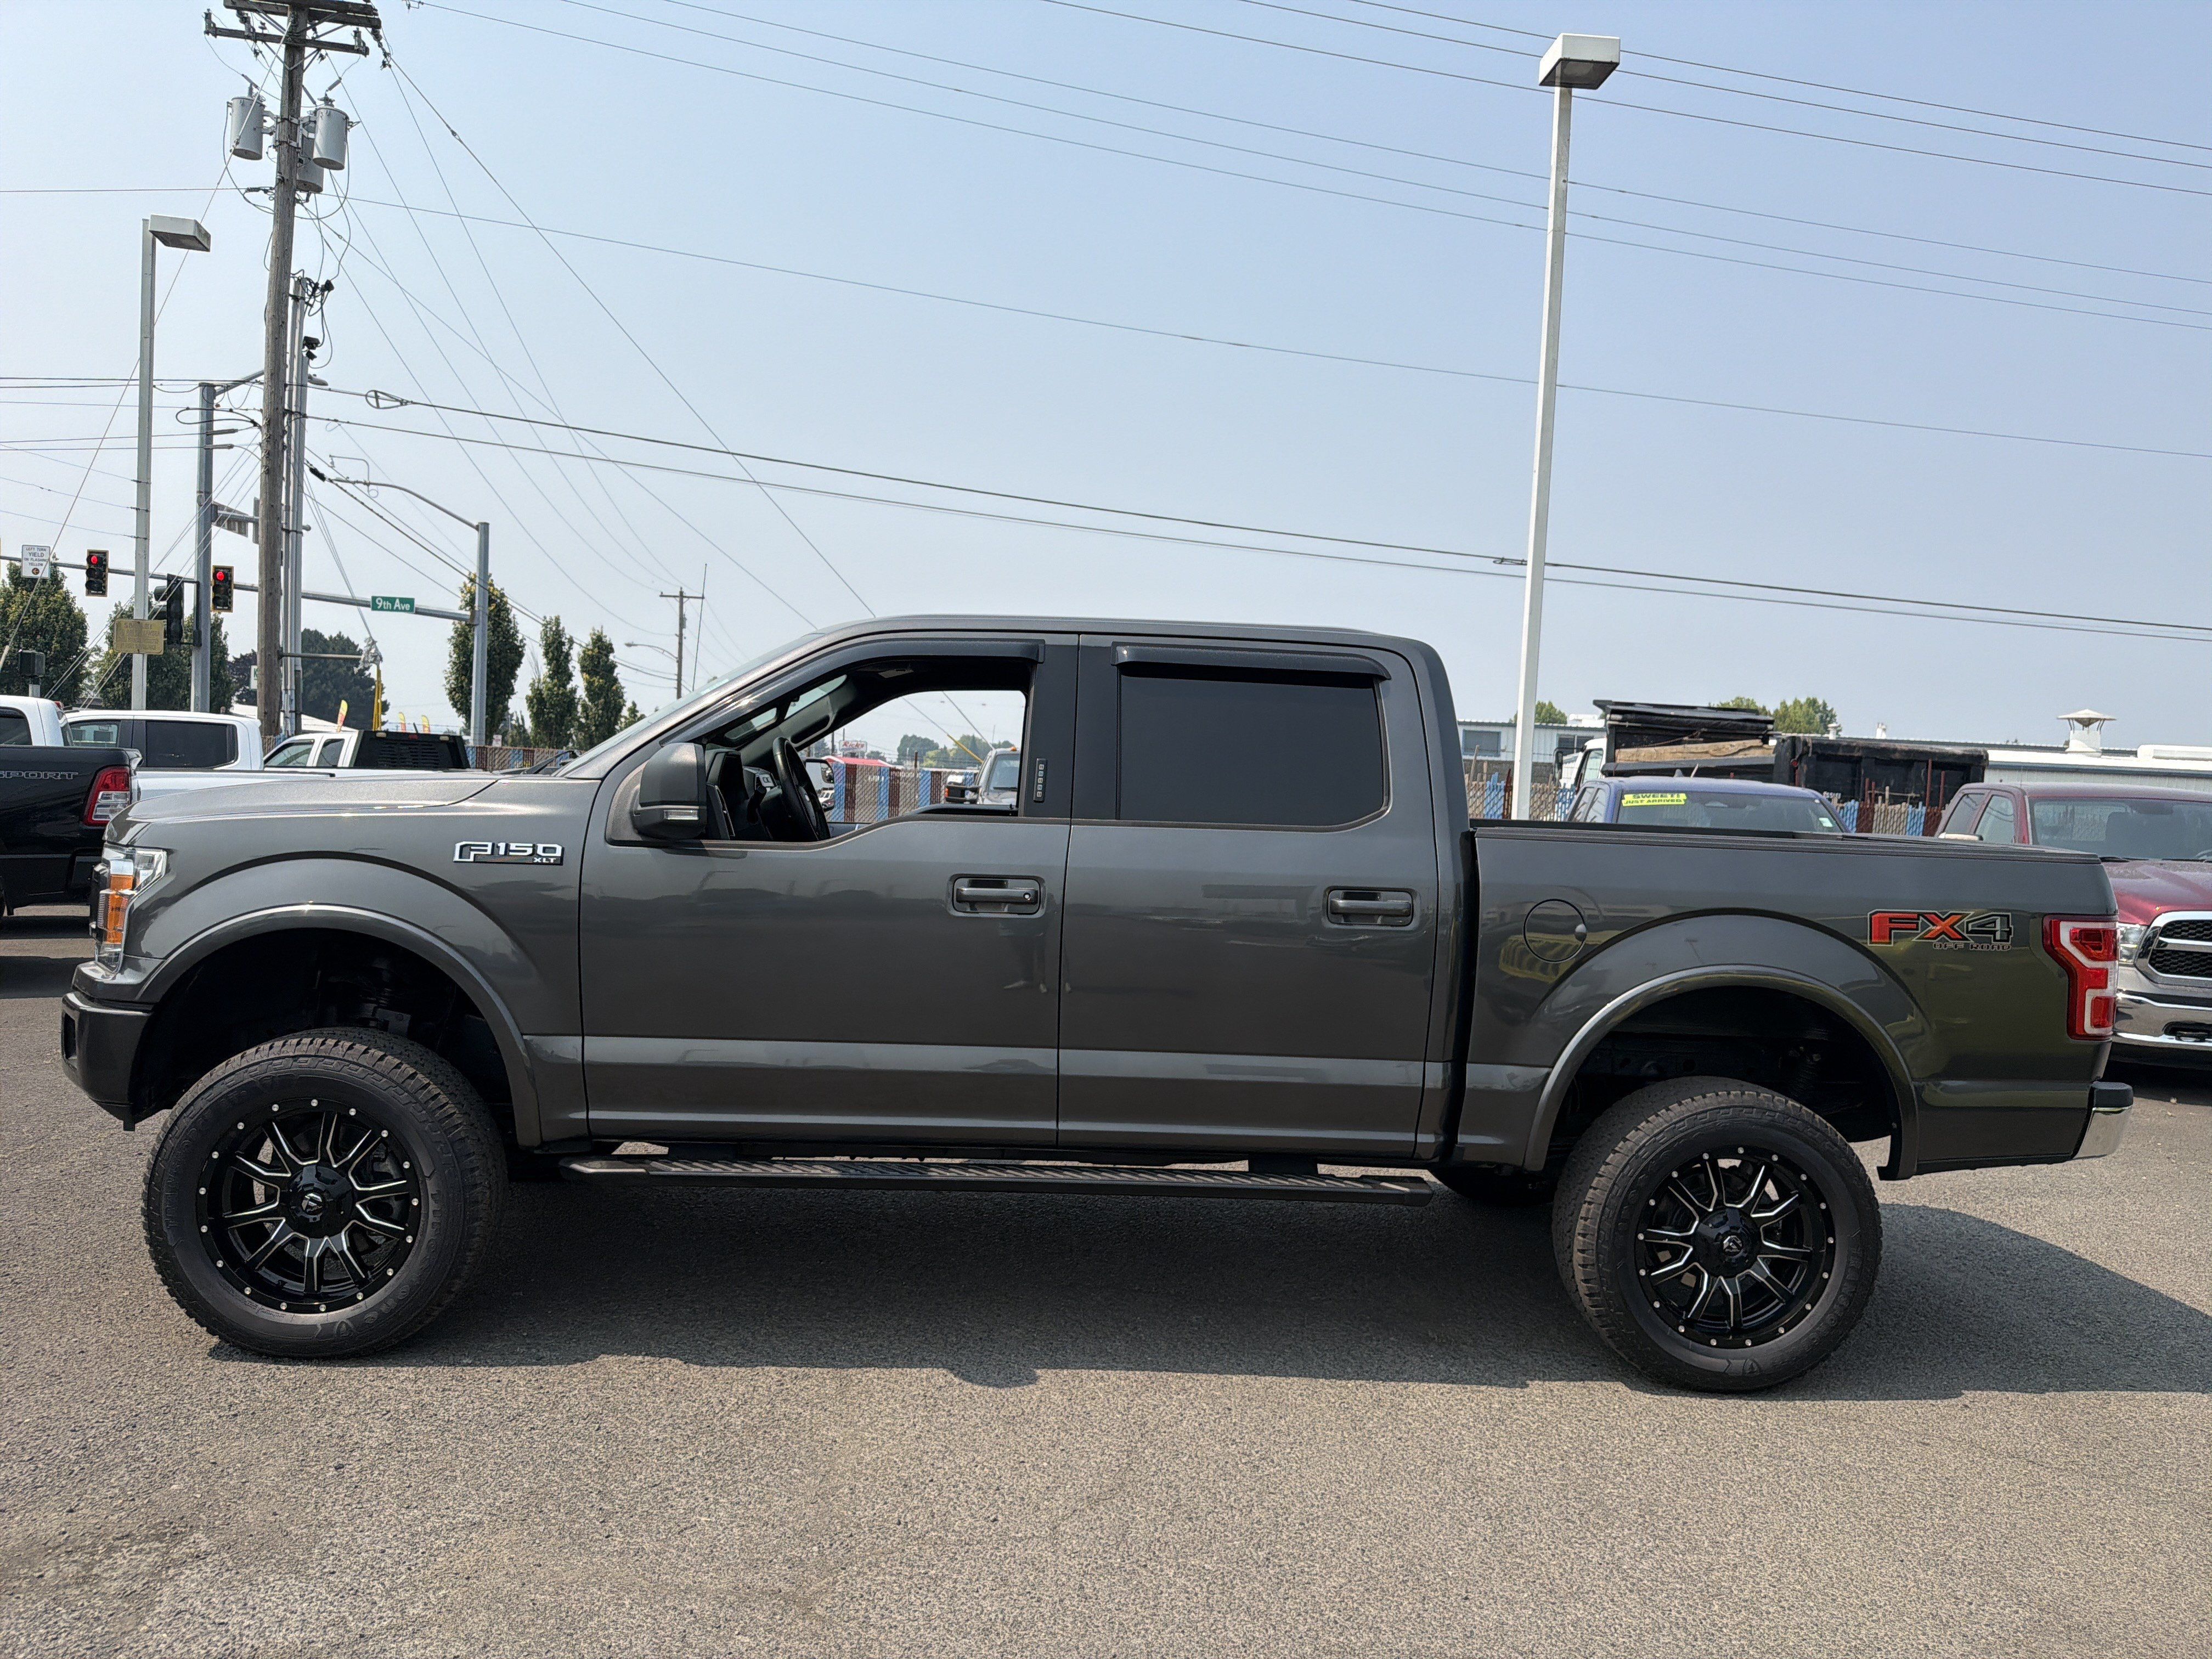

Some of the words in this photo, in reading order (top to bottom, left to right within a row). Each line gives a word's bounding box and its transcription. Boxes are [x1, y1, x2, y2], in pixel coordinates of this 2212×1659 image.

[375, 597, 392, 610] 9th
[393, 598, 411, 611] Ave
[0, 770, 78, 780] PORT
[1867, 909, 2014, 946] FX4
[1969, 943, 2012, 951] ROAD
